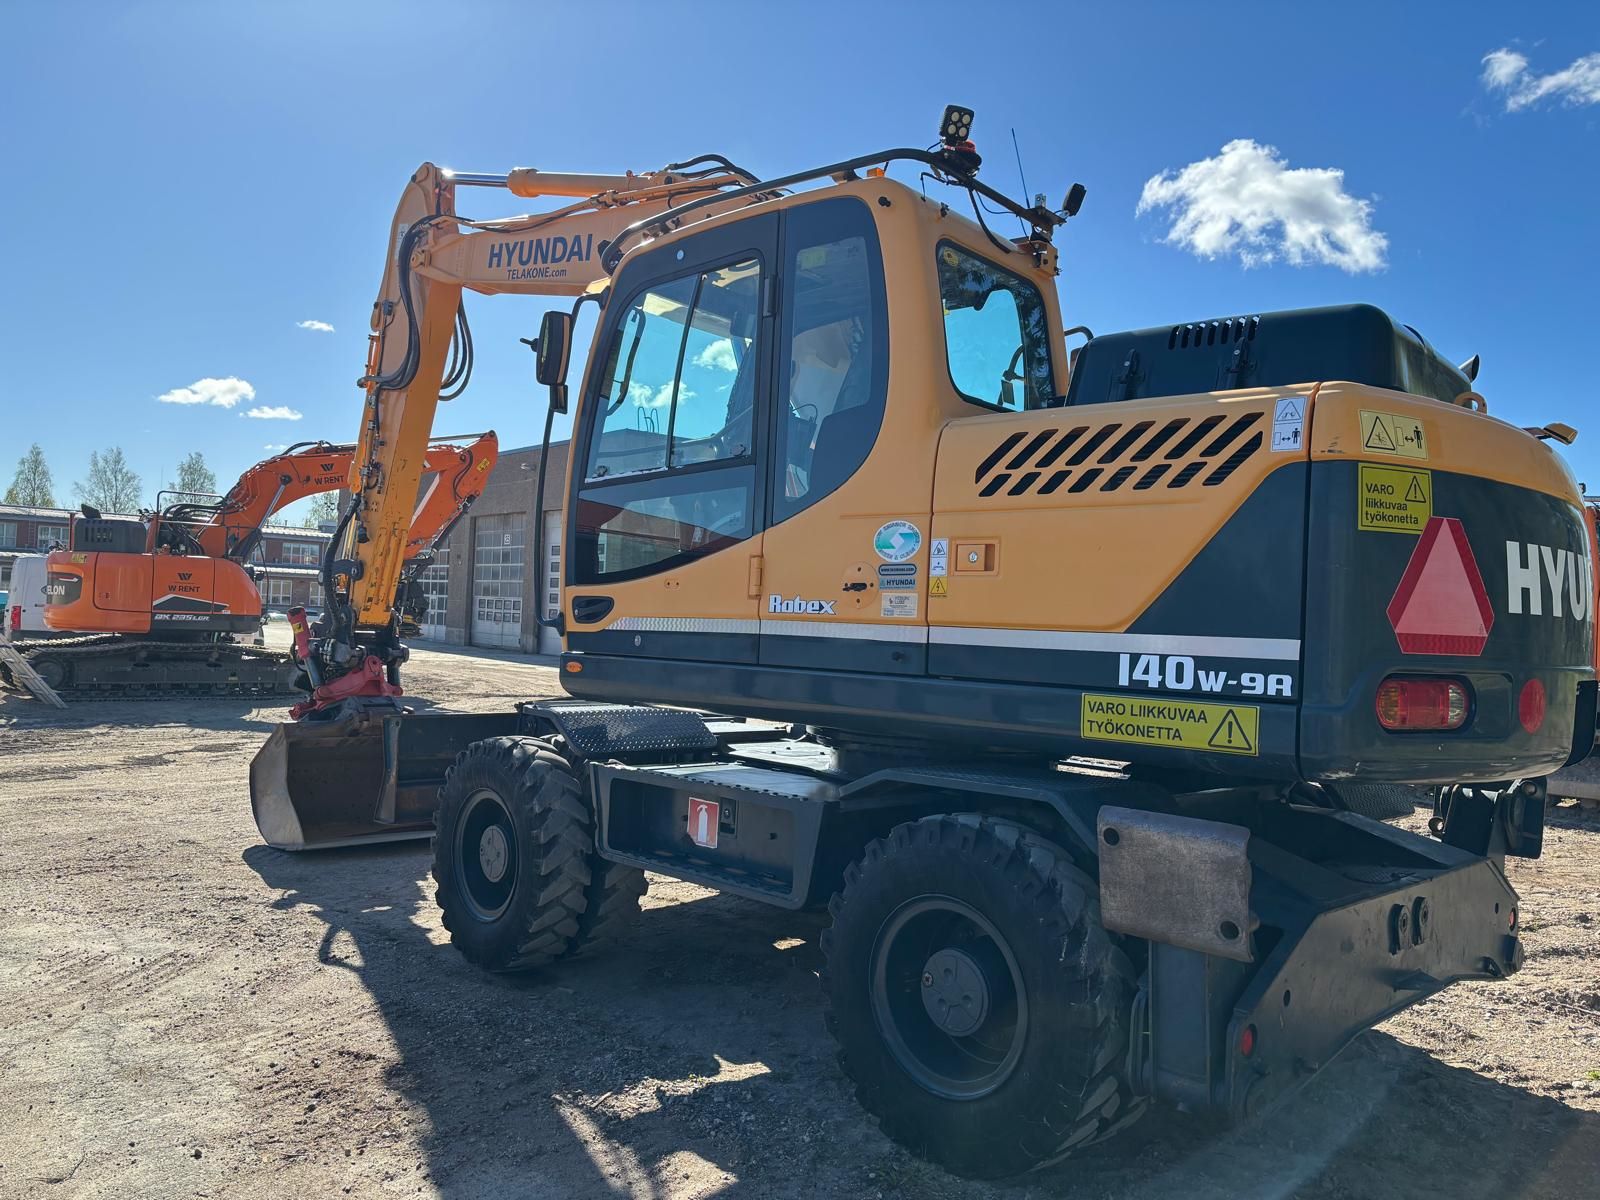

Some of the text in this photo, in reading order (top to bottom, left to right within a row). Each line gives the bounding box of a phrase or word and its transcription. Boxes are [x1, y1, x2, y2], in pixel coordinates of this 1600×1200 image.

[488, 233, 593, 268] HYUNDAI
[507, 267, 567, 280] TELAKONE.com
[324, 475, 344, 484] RENT
[1365, 482, 1394, 495] VARO
[1365, 498, 1408, 511] liikkuvaa
[1365, 511, 1419, 525] työkonetta
[886, 578, 916, 586] HYUNDAI
[178, 585, 201, 593] RENT
[768, 593, 837, 615] Robex
[1087, 700, 1208, 724] VARO LIIKKUVAA
[1087, 718, 1183, 742] TYÖKONETTA
